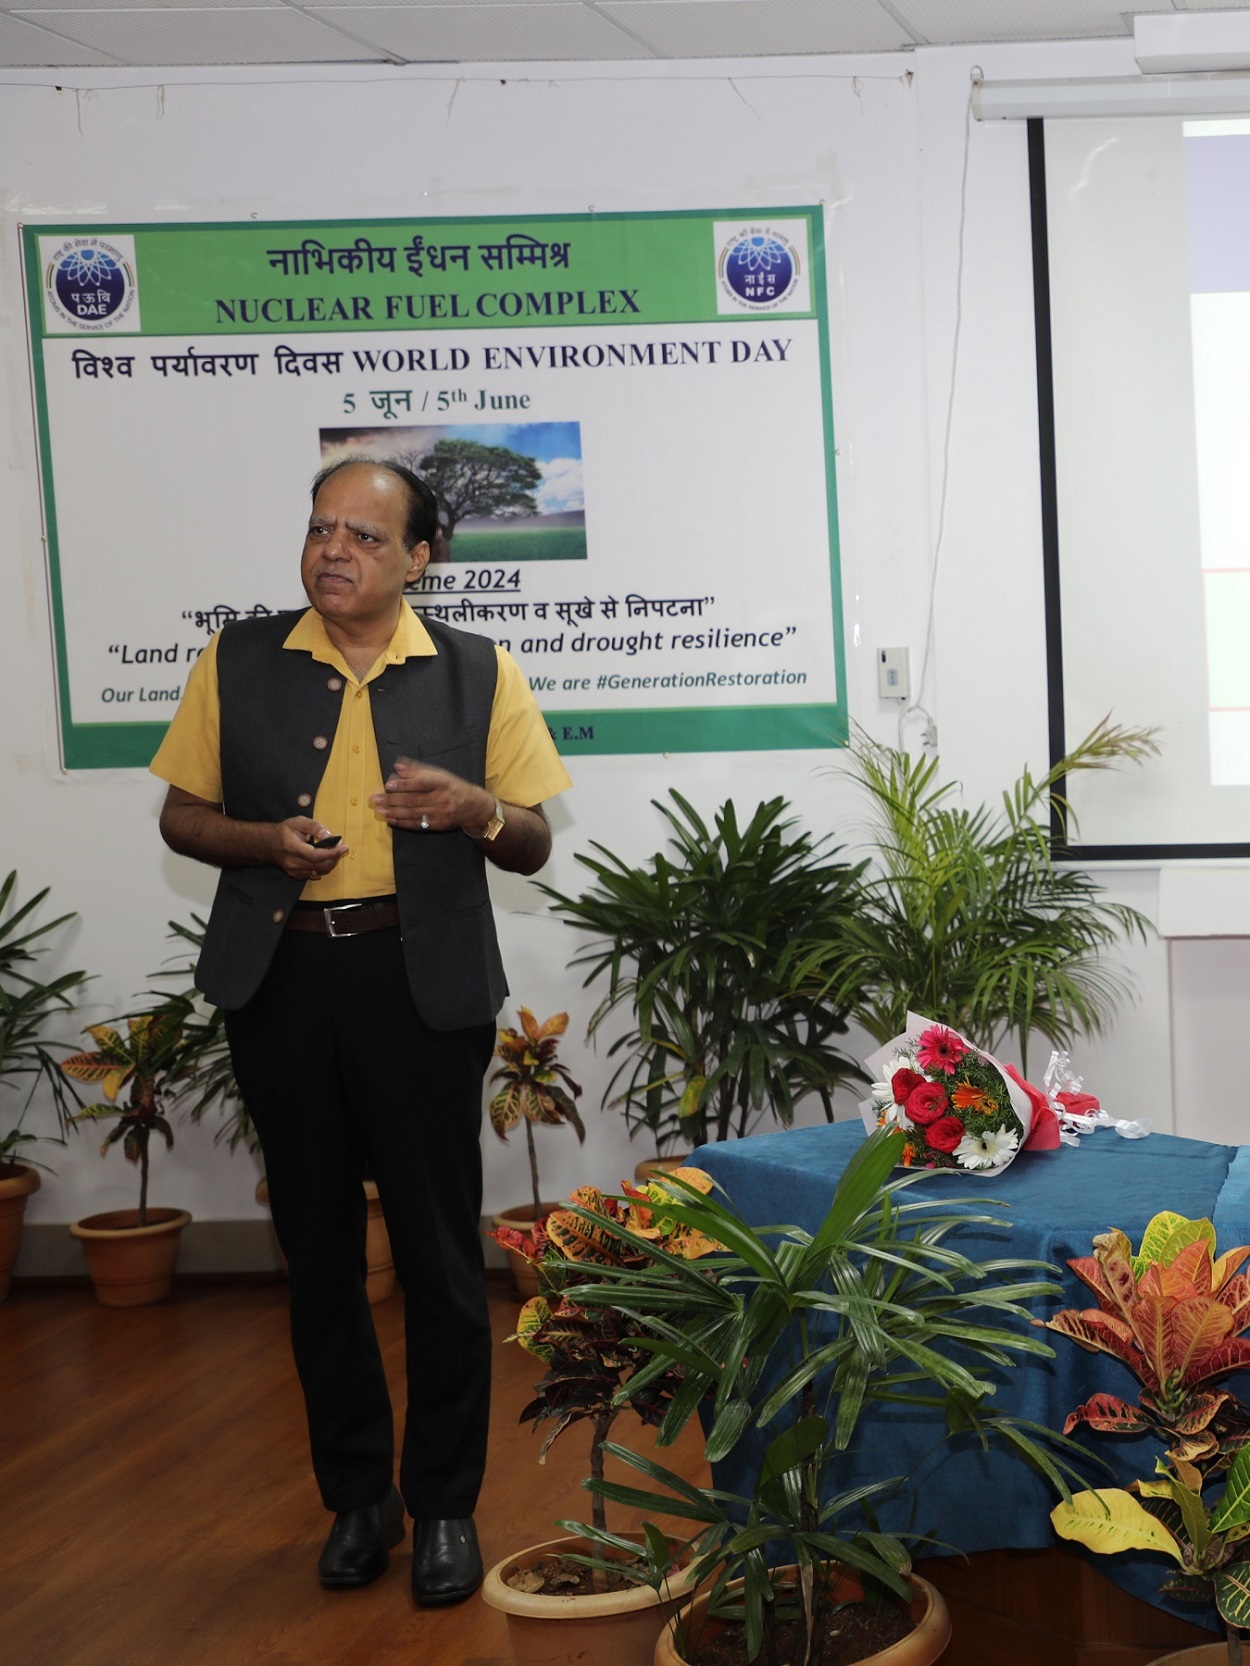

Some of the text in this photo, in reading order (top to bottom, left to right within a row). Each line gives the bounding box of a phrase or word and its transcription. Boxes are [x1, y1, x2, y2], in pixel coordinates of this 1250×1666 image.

[266, 234, 571, 278] नाभिकीय ईंधन सम्मिश्र
[745, 286, 775, 296] NFC
[47, 290, 60, 313] ATOMS
[66, 317, 77, 327] THE
[79, 323, 103, 331] SERVICE
[104, 320, 113, 328] OF
[113, 313, 125, 323] THE
[123, 289, 135, 312] NATION
[77, 304, 107, 315] DAE
[215, 289, 641, 325] NUCLEAR FUEL COMPLEX
[72, 338, 793, 379] विश्व पर्यावरण दिवस WORLD ENVIRONMENT DAY
[343, 389, 531, 420] 5 जून / 5th June
[463, 569, 521, 590] 2024
[533, 603, 549, 620] व
[555, 596, 595, 628] सूखे
[600, 596, 620, 619] से
[521, 633, 564, 653] and
[571, 631, 664, 655] drought
[671, 626, 797, 650] resilience”
[108, 643, 178, 664] “Land
[529, 669, 808, 691] We are #GenerationRestoration
[101, 687, 135, 703] Our
[562, 726, 595, 740] E.M
